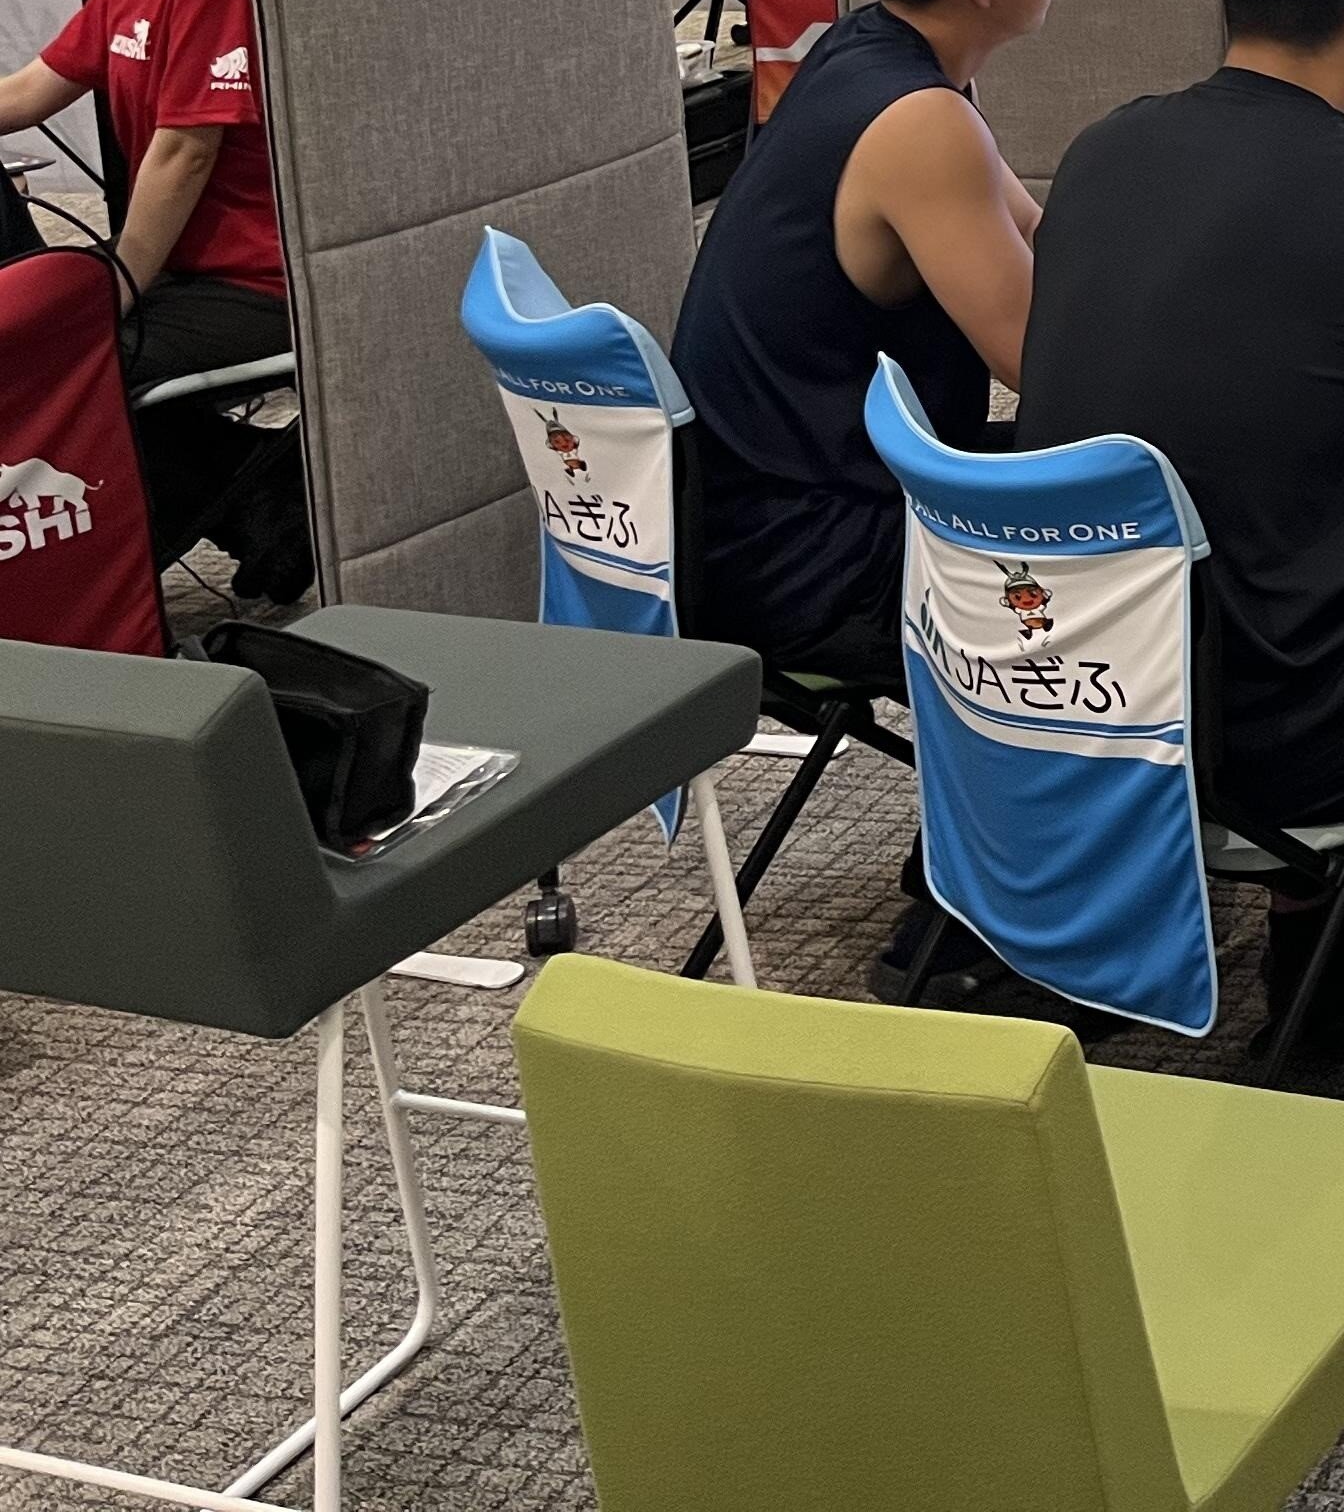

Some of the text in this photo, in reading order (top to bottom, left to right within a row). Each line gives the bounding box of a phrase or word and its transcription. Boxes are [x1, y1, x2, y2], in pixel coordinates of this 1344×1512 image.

[529, 378, 574, 395] FOR
[575, 380, 631, 398] ONE
[543, 490, 639, 549] Aぎふ
[952, 514, 999, 539] ALL
[1002, 525, 1063, 542] FOR
[1068, 522, 1142, 542] ONE
[955, 648, 1126, 714] JAぎふ
